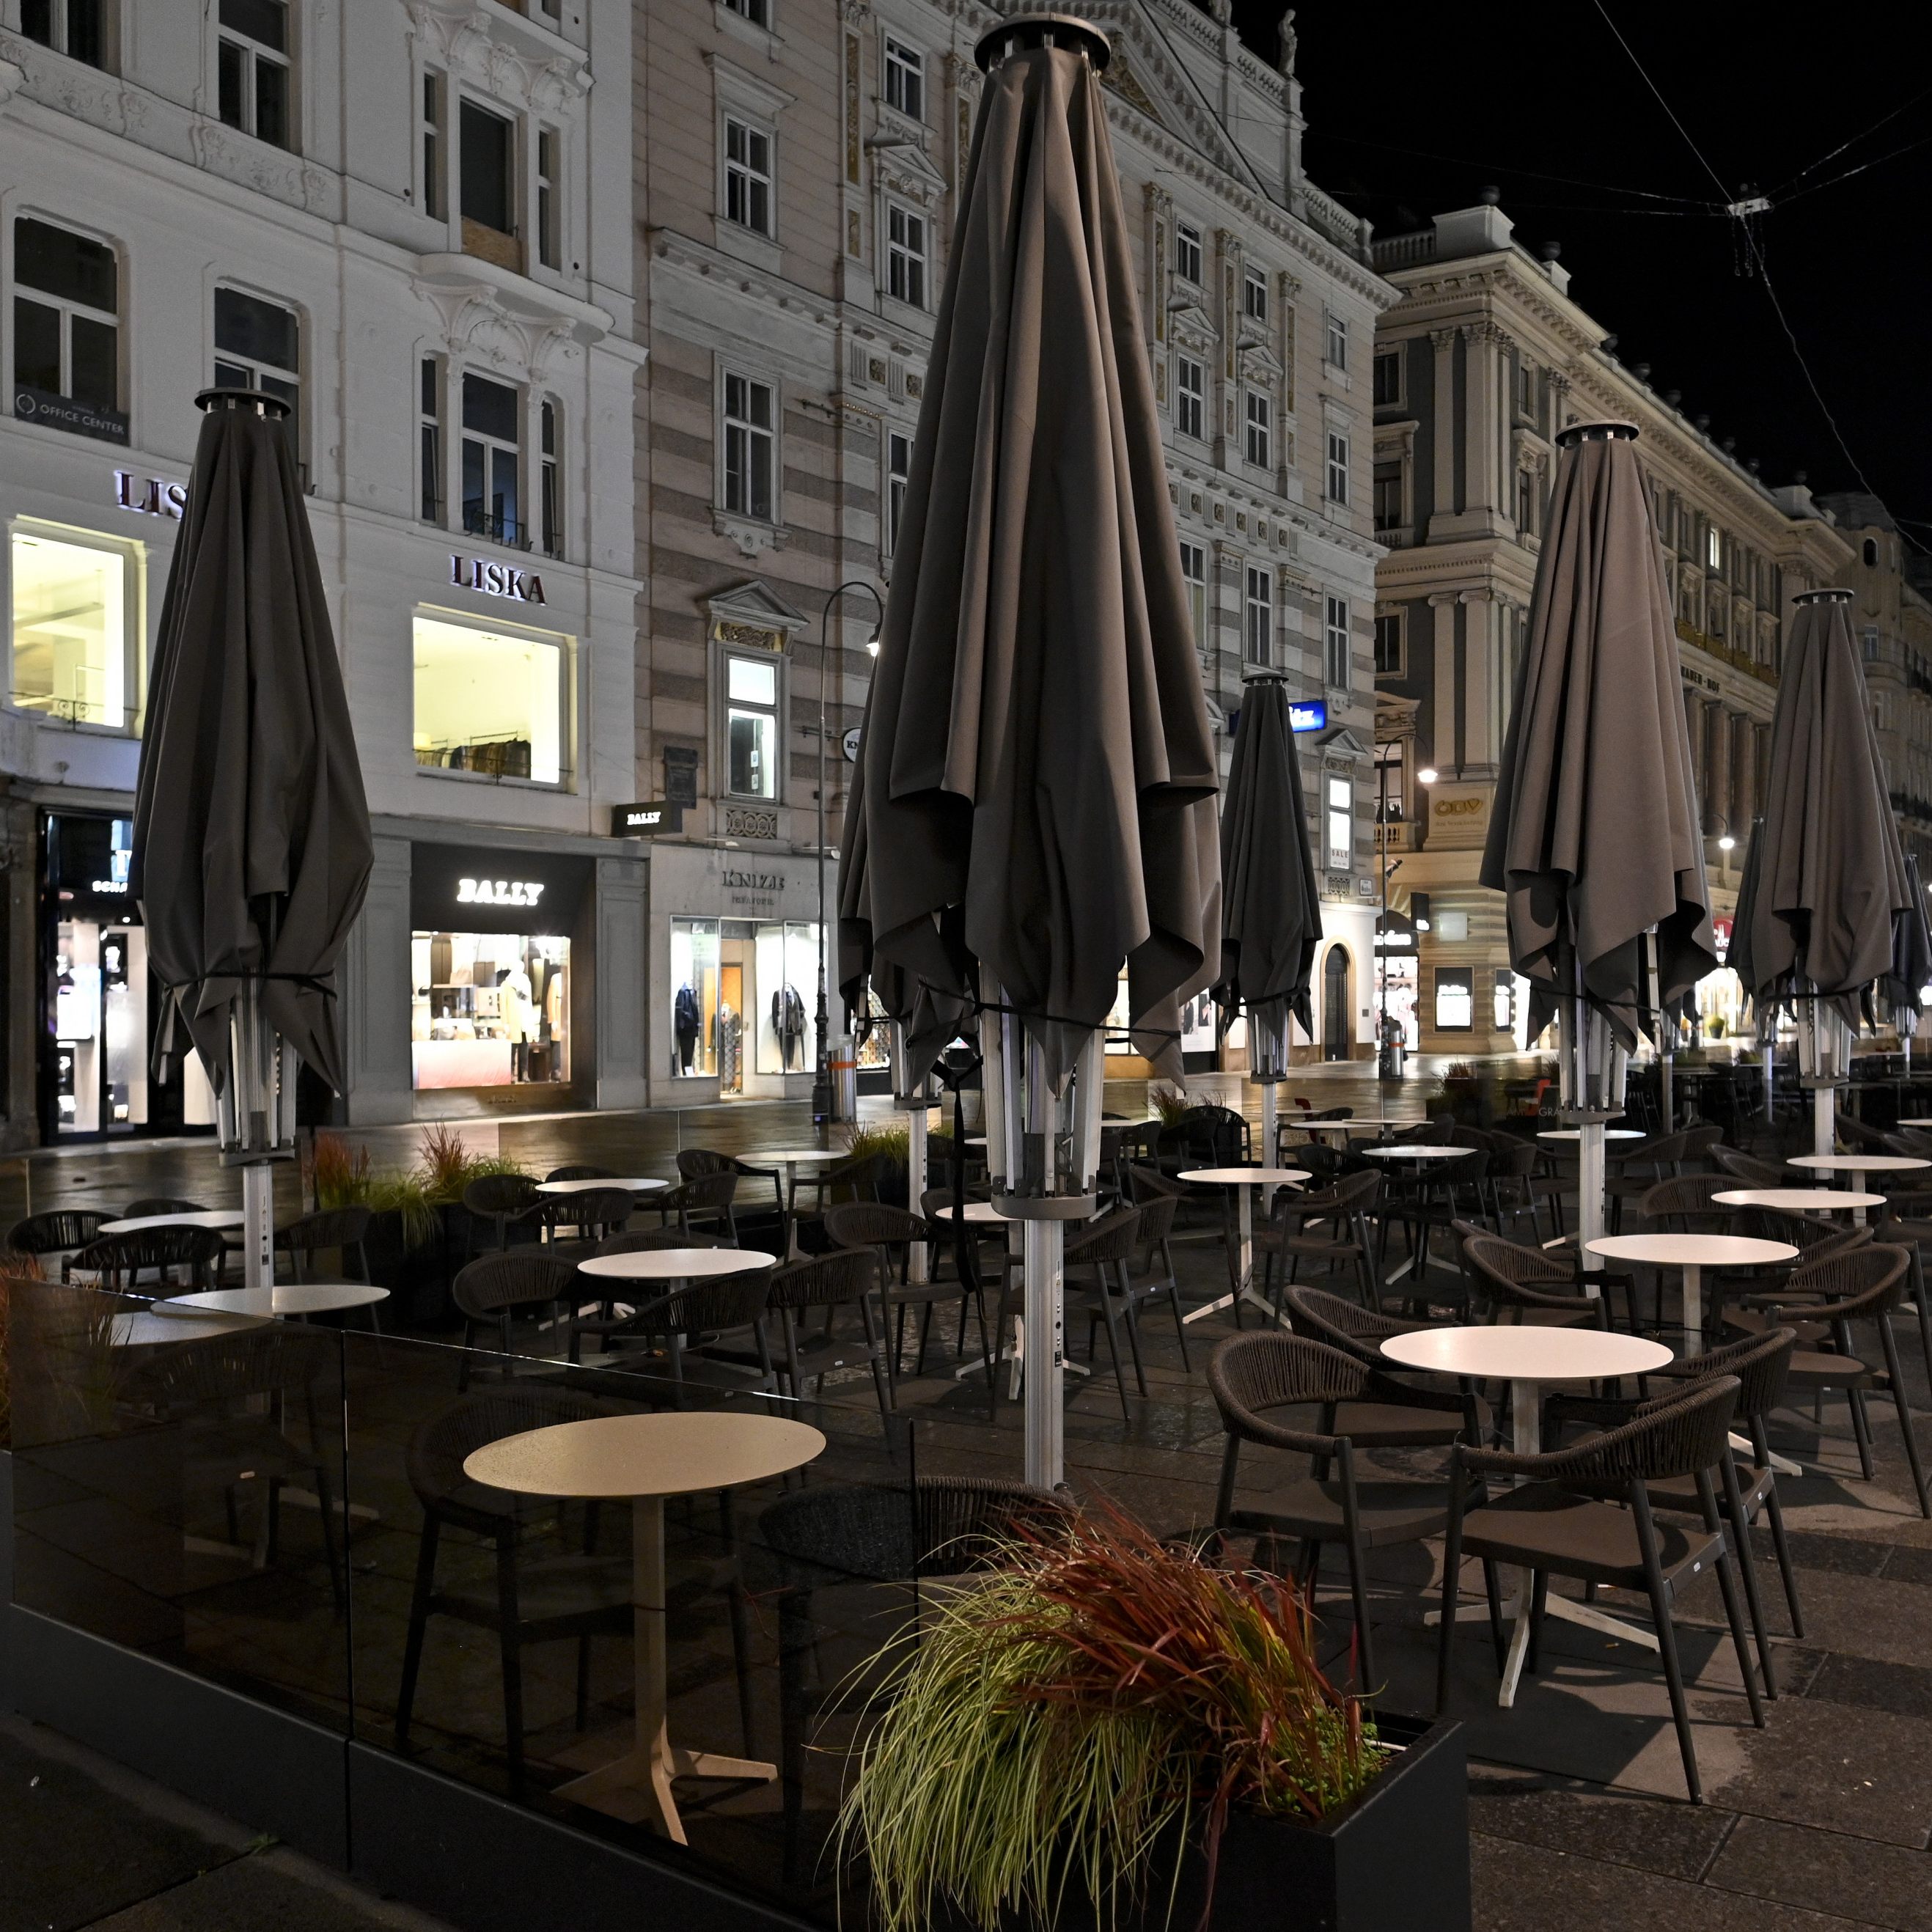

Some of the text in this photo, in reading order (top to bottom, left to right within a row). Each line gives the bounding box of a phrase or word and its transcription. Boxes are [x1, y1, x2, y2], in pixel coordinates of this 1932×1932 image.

[40, 404, 79, 422] OFFICE
[82, 416, 125, 435] CENTER
[450, 554, 548, 606] LISKA
[627, 811, 661, 826] BALLY
[1332, 849, 1348, 859] SALE
[456, 878, 545, 906] BALLY
